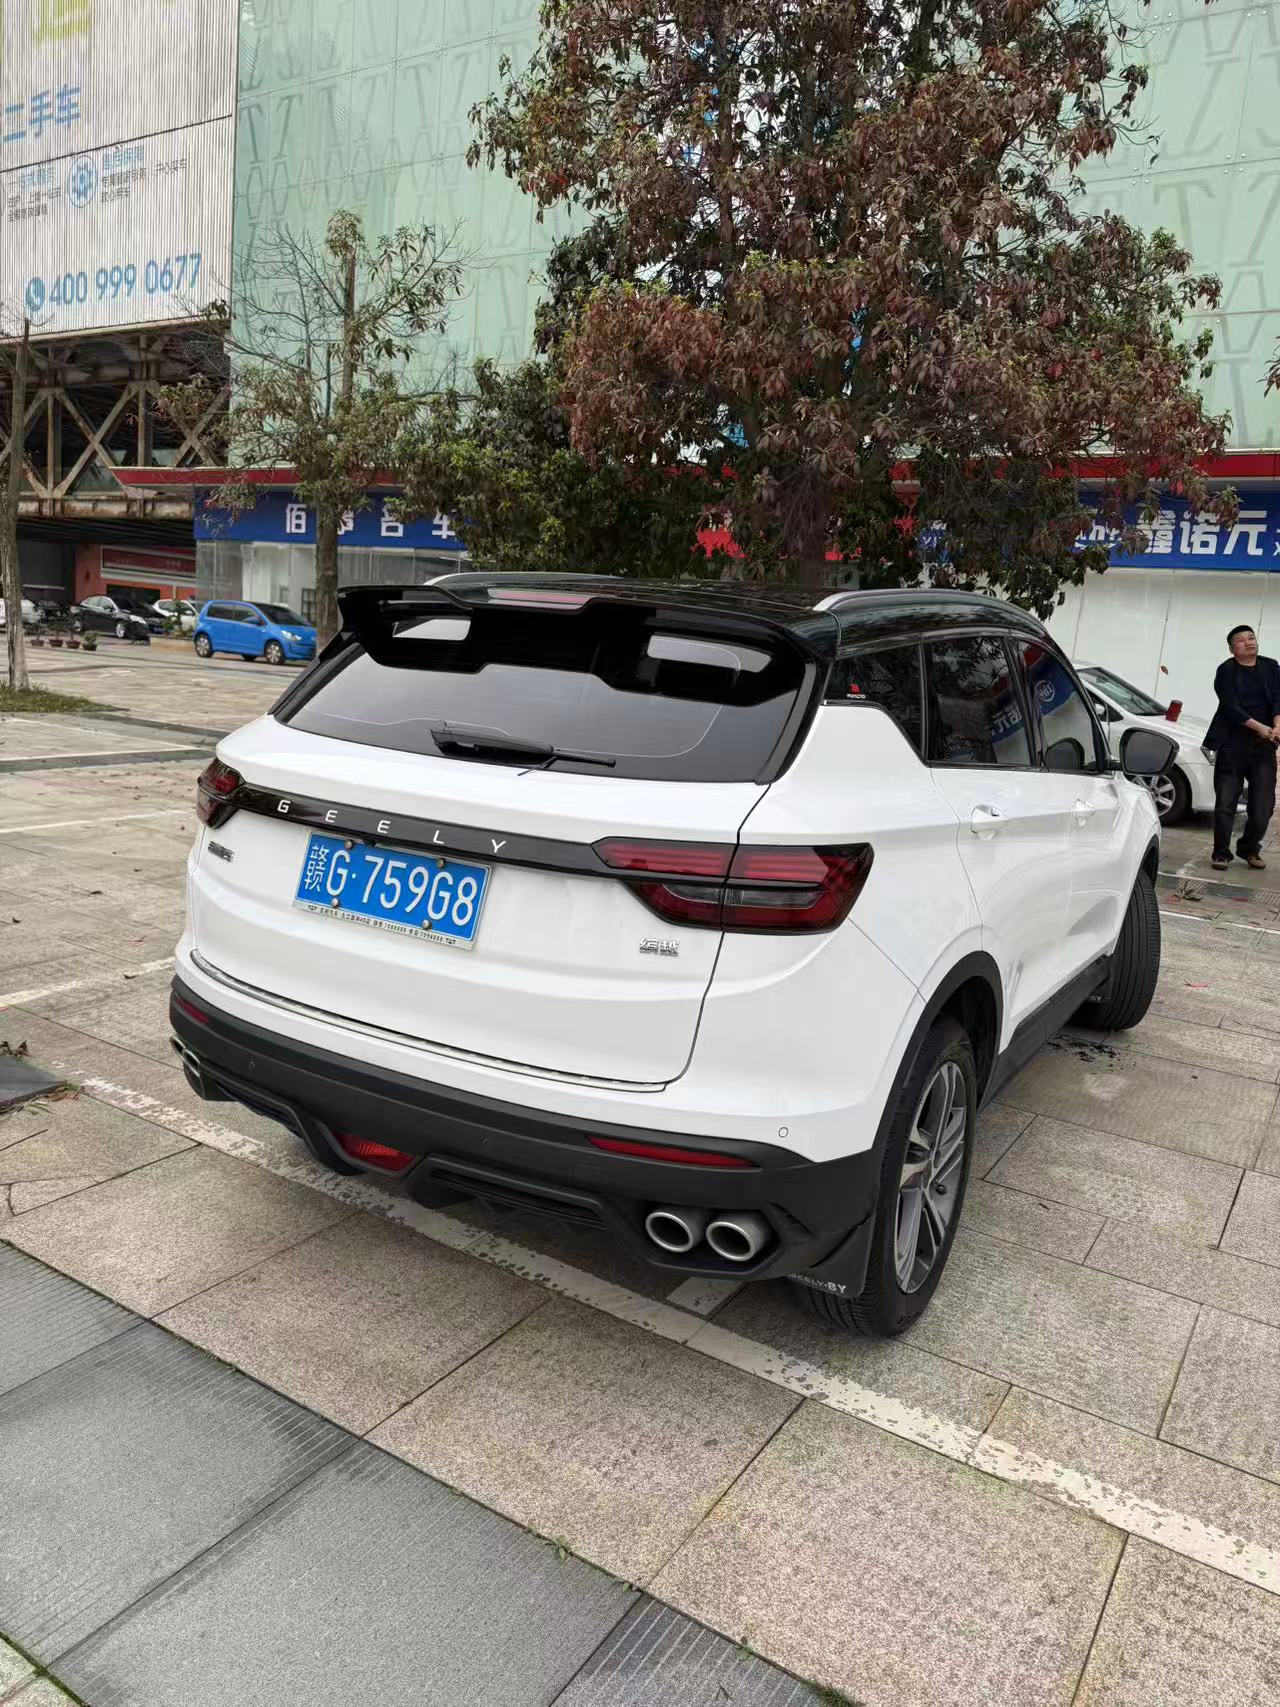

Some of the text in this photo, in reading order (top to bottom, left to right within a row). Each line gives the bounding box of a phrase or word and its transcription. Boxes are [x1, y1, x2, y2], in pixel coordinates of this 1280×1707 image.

[2, 85, 80, 141] 二手车
[49, 251, 202, 306] 400 999 0677
[277, 800, 506, 854] GEELY
